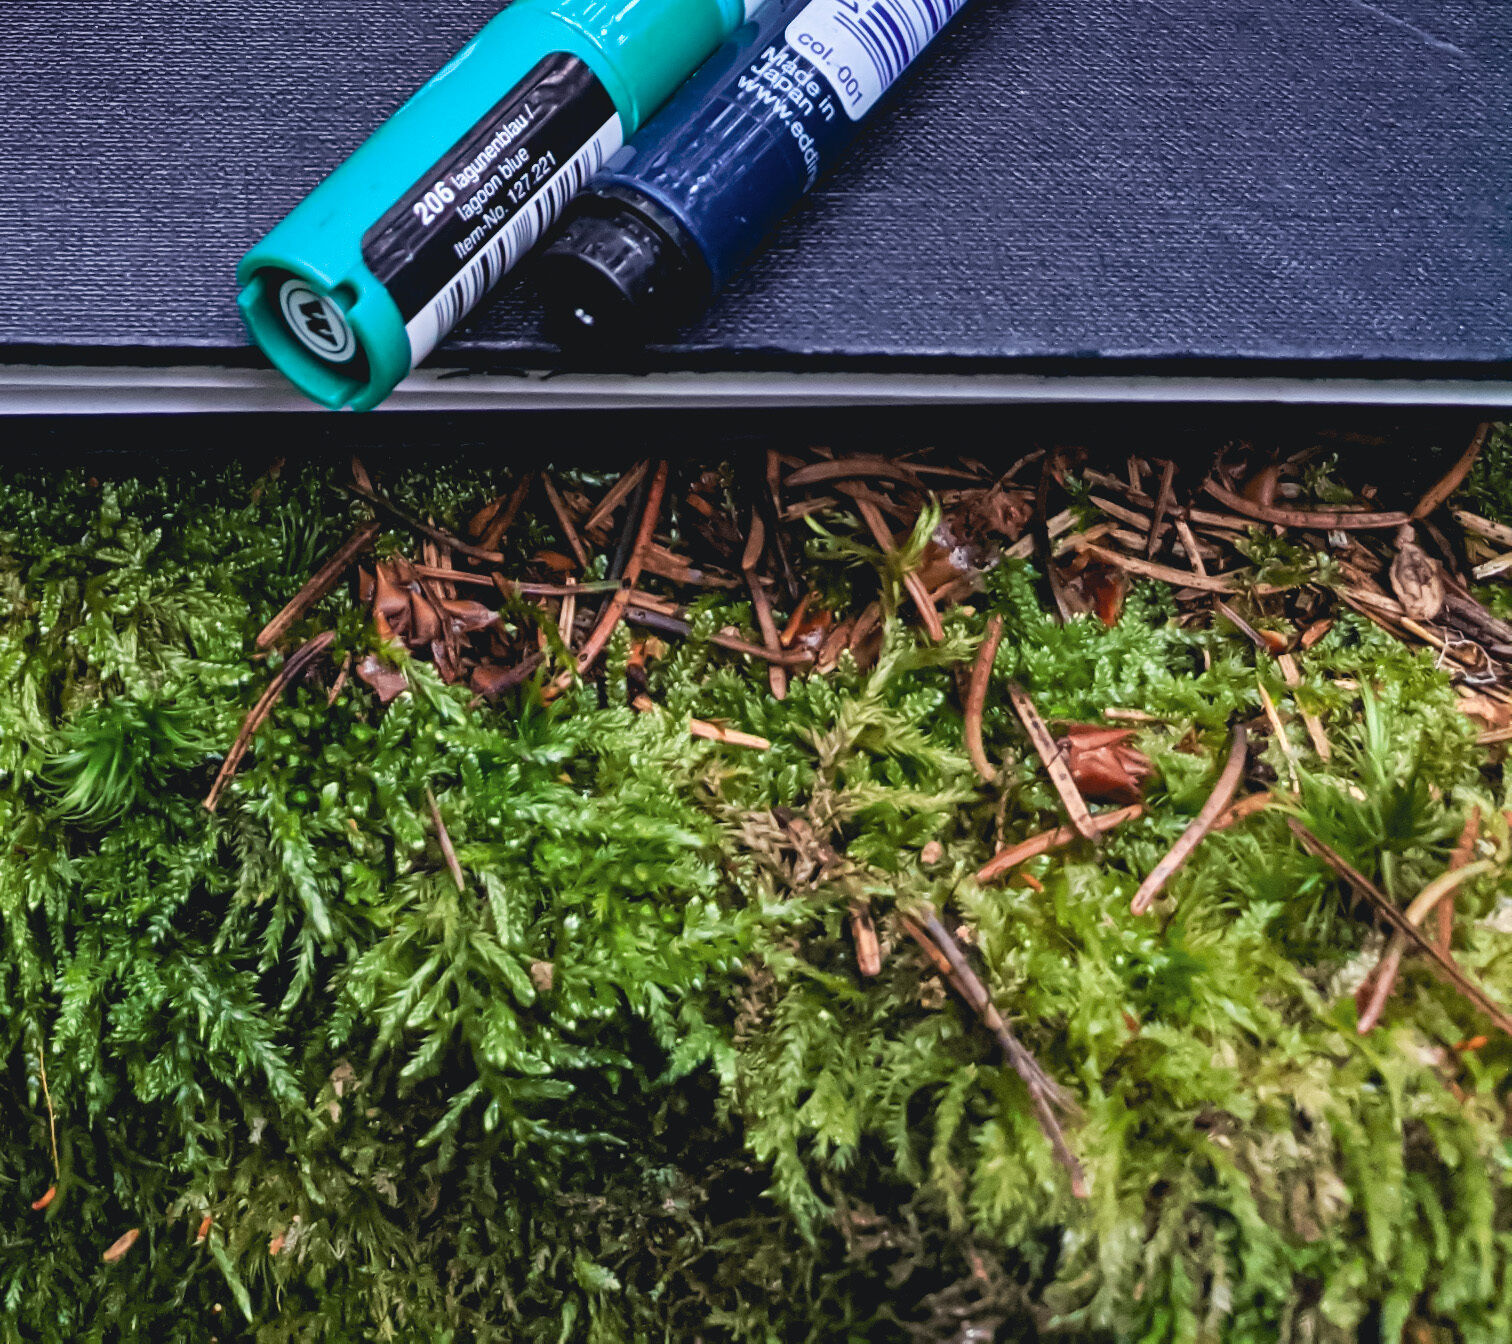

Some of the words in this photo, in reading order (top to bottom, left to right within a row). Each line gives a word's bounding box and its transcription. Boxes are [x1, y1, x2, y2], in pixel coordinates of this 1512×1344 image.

[751, 62, 814, 116] Japan
[760, 46, 820, 97] Made
[819, 94, 835, 122] in
[798, 33, 833, 65] col.
[838, 66, 863, 107] 001
[412, 180, 456, 227] 206
[450, 116, 529, 190] lagunenblau
[524, 103, 535, 119] /
[456, 173, 503, 222] lagoon
[497, 147, 530, 180] blue
[453, 204, 509, 260] Item-No.
